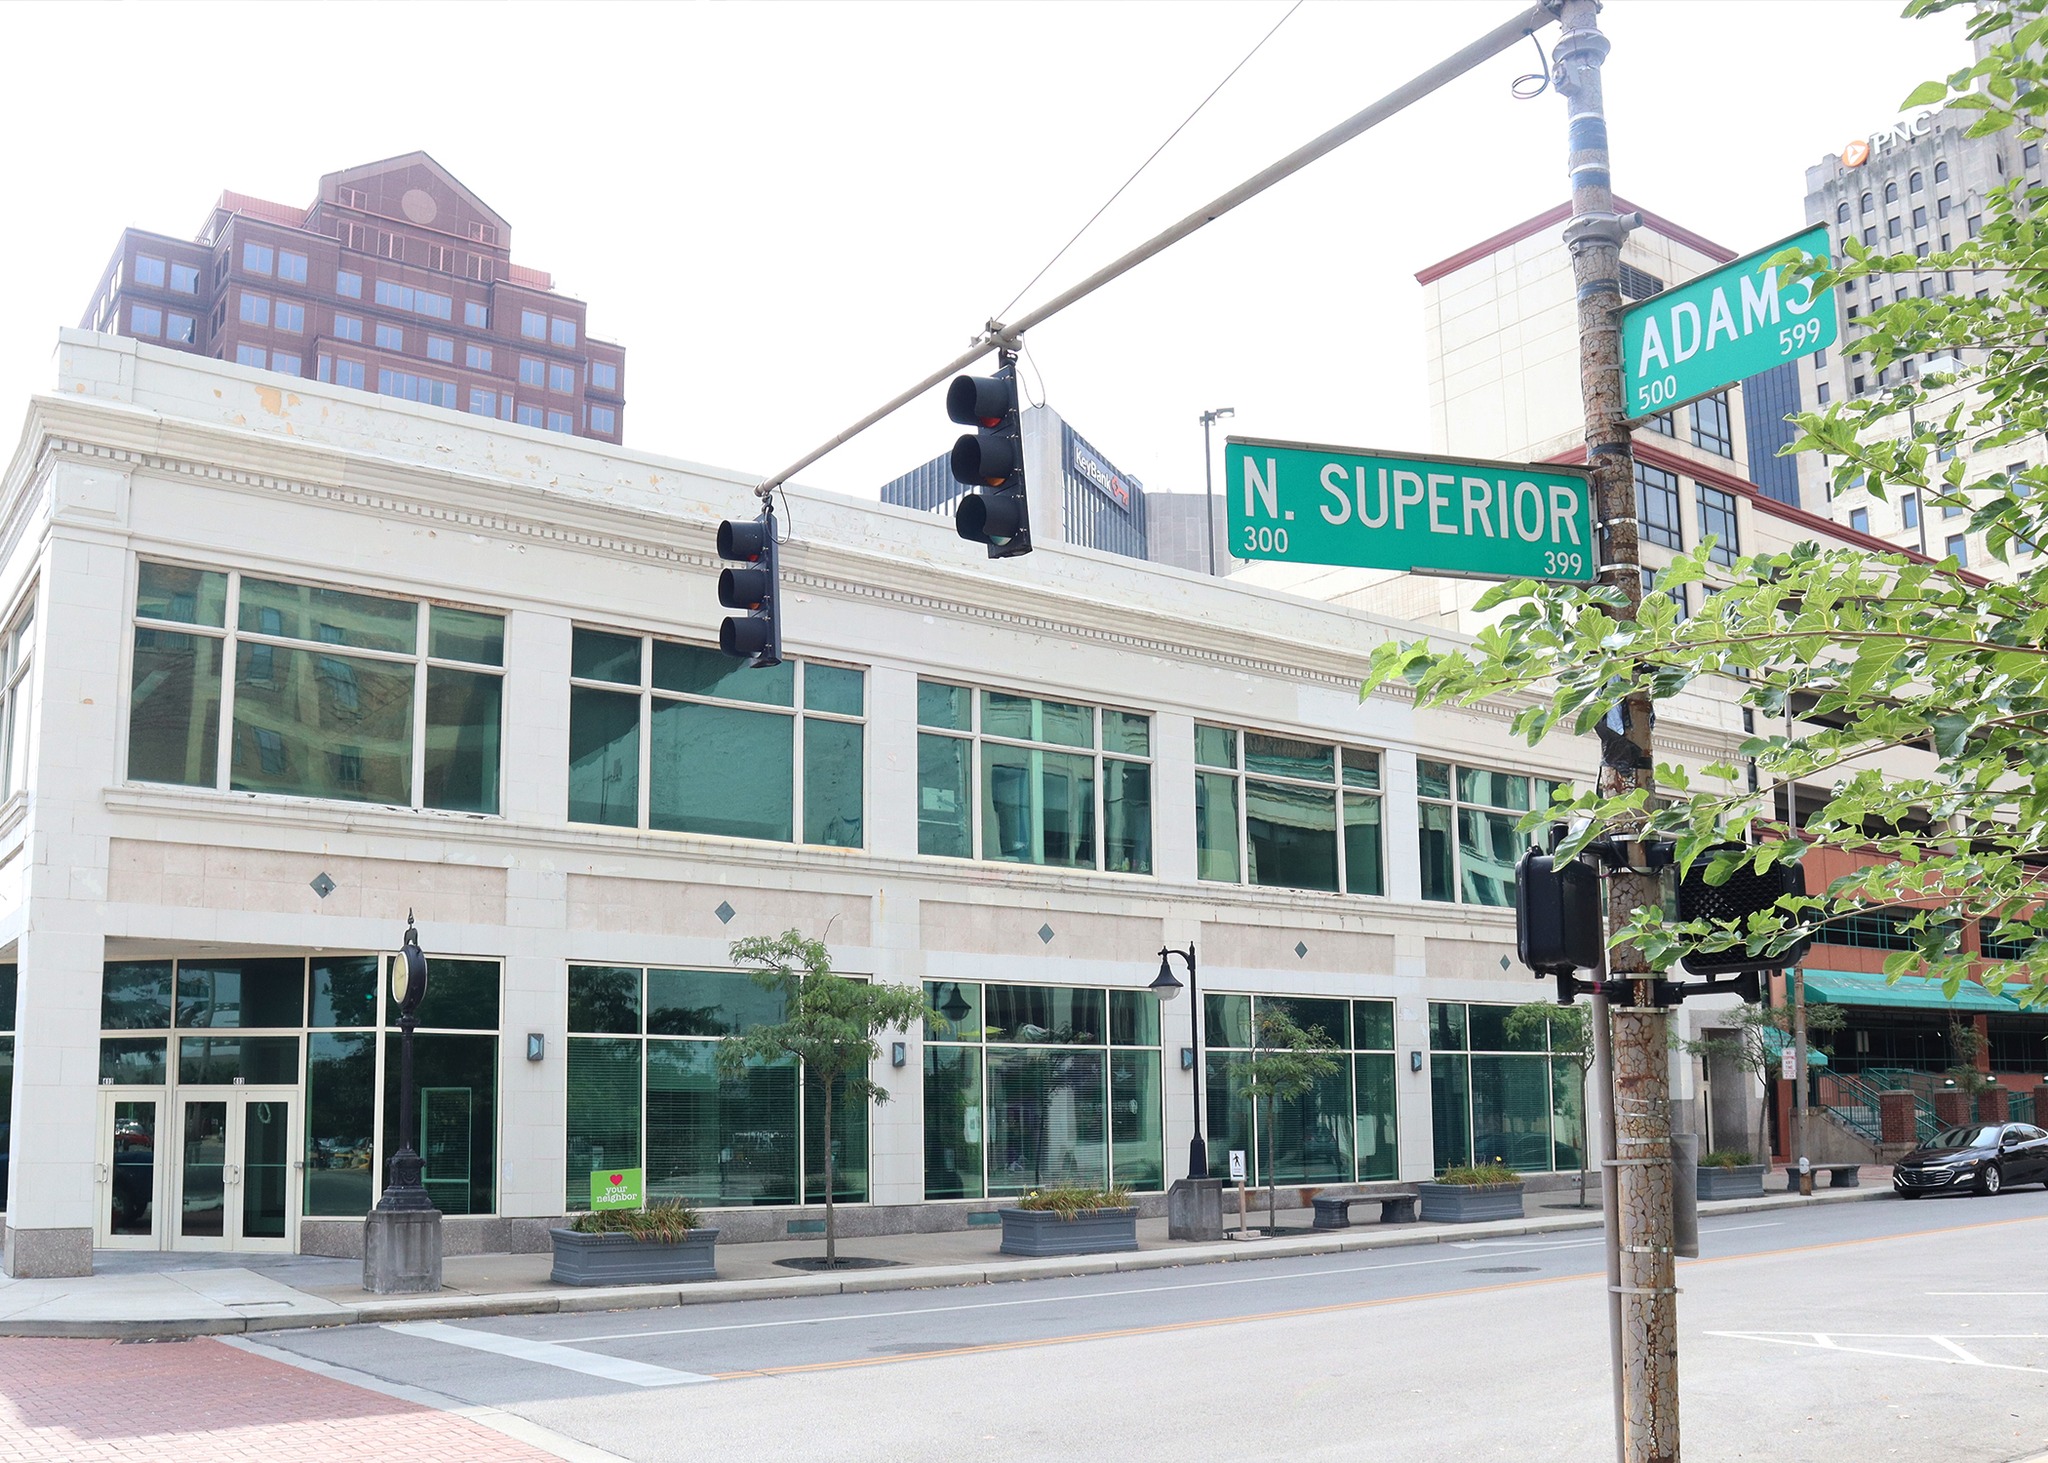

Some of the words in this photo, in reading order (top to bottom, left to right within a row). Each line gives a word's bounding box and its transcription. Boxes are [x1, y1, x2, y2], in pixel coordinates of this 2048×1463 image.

[1870, 110, 1931, 155] PNC
[1779, 317, 1821, 356] 599
[1638, 375, 1677, 410] 500
[1075, 446, 1112, 492] KeyBank
[1243, 455, 1295, 521] N.
[1319, 462, 1582, 546] SUPERIOR
[1243, 526, 1289, 554] 300
[1543, 550, 1583, 577] 399
[596, 1193, 638, 1203] neighbor
[605, 1186, 628, 1195] your
